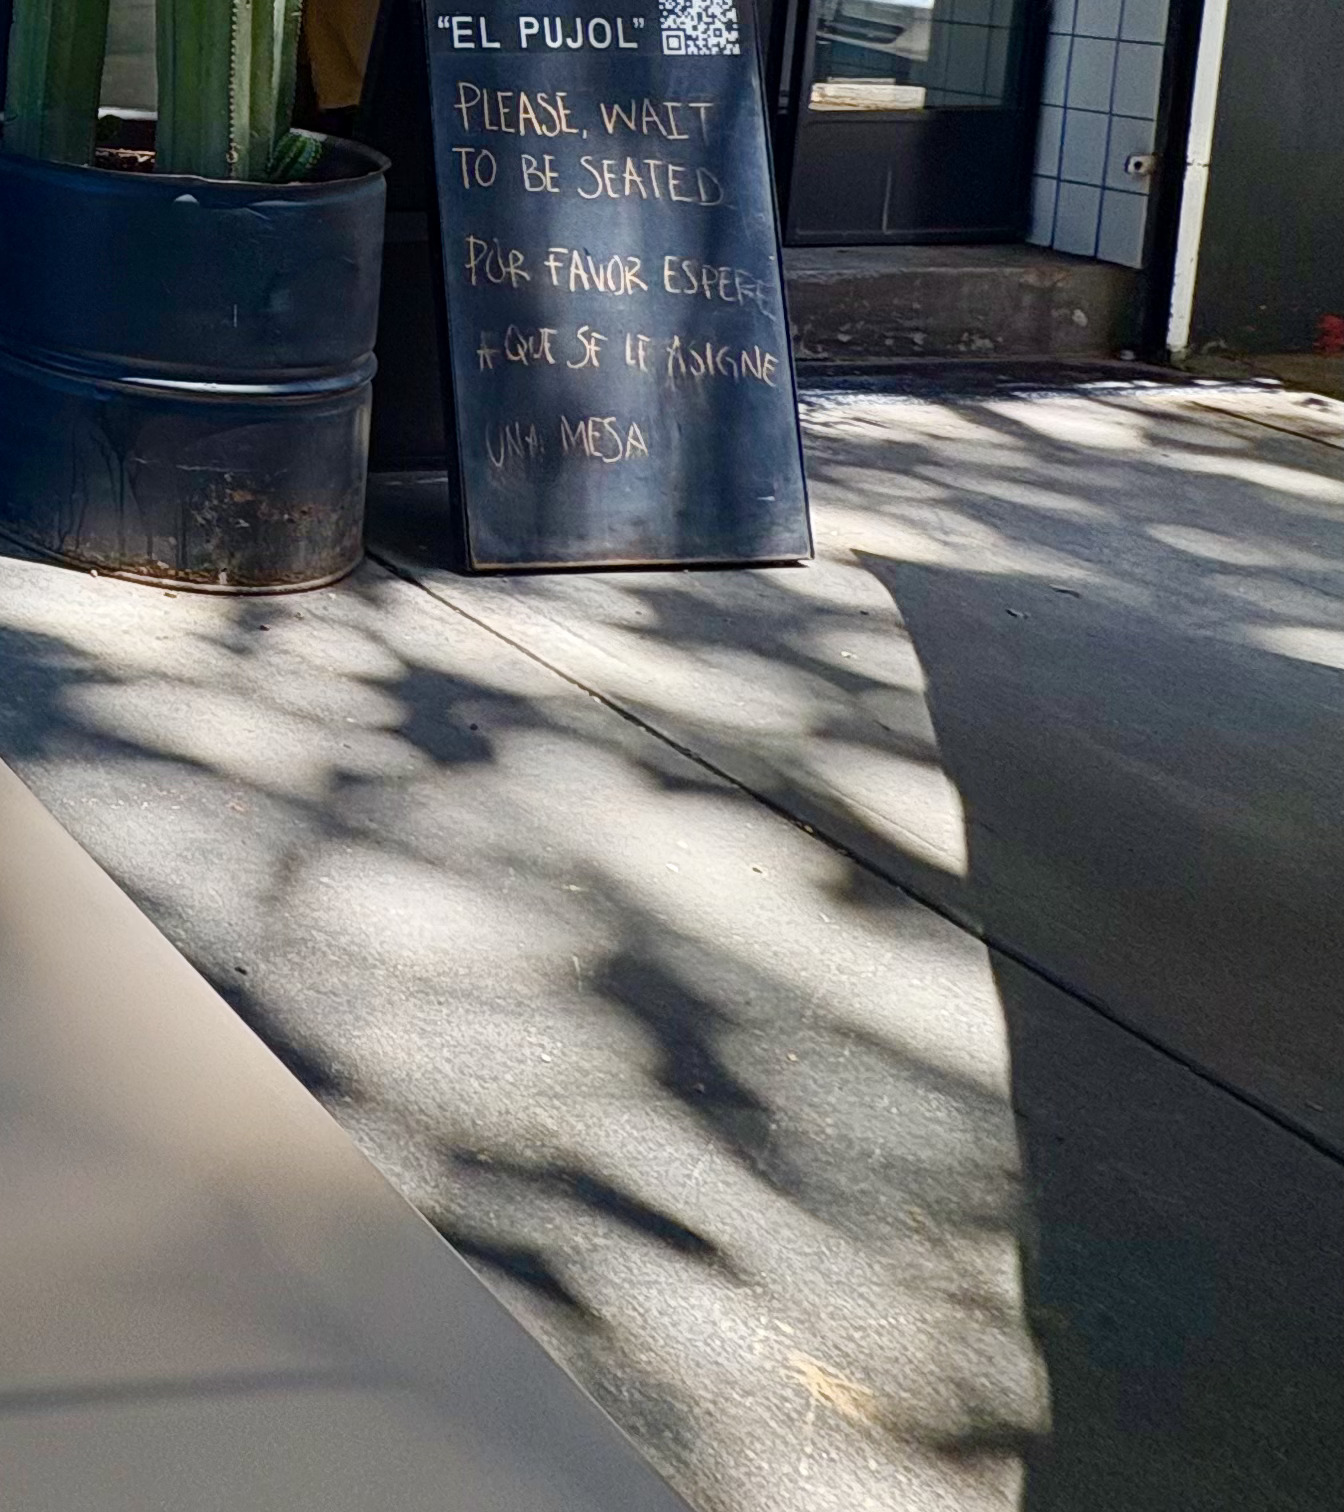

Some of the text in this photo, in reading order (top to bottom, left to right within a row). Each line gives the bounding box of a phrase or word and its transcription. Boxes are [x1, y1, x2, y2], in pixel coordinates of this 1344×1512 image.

[437, 16, 645, 49] “EL PUJOL”
[600, 98, 714, 139] WAIT
[452, 148, 725, 206] TO BE SEATED
[465, 235, 530, 287] POR
[544, 248, 648, 295] FAVOR
[504, 325, 558, 366] QUE
[567, 326, 608, 369] SE
[626, 333, 650, 371] LE
[666, 335, 779, 387] ASIGNE
[485, 415, 648, 467] UNA MESA
